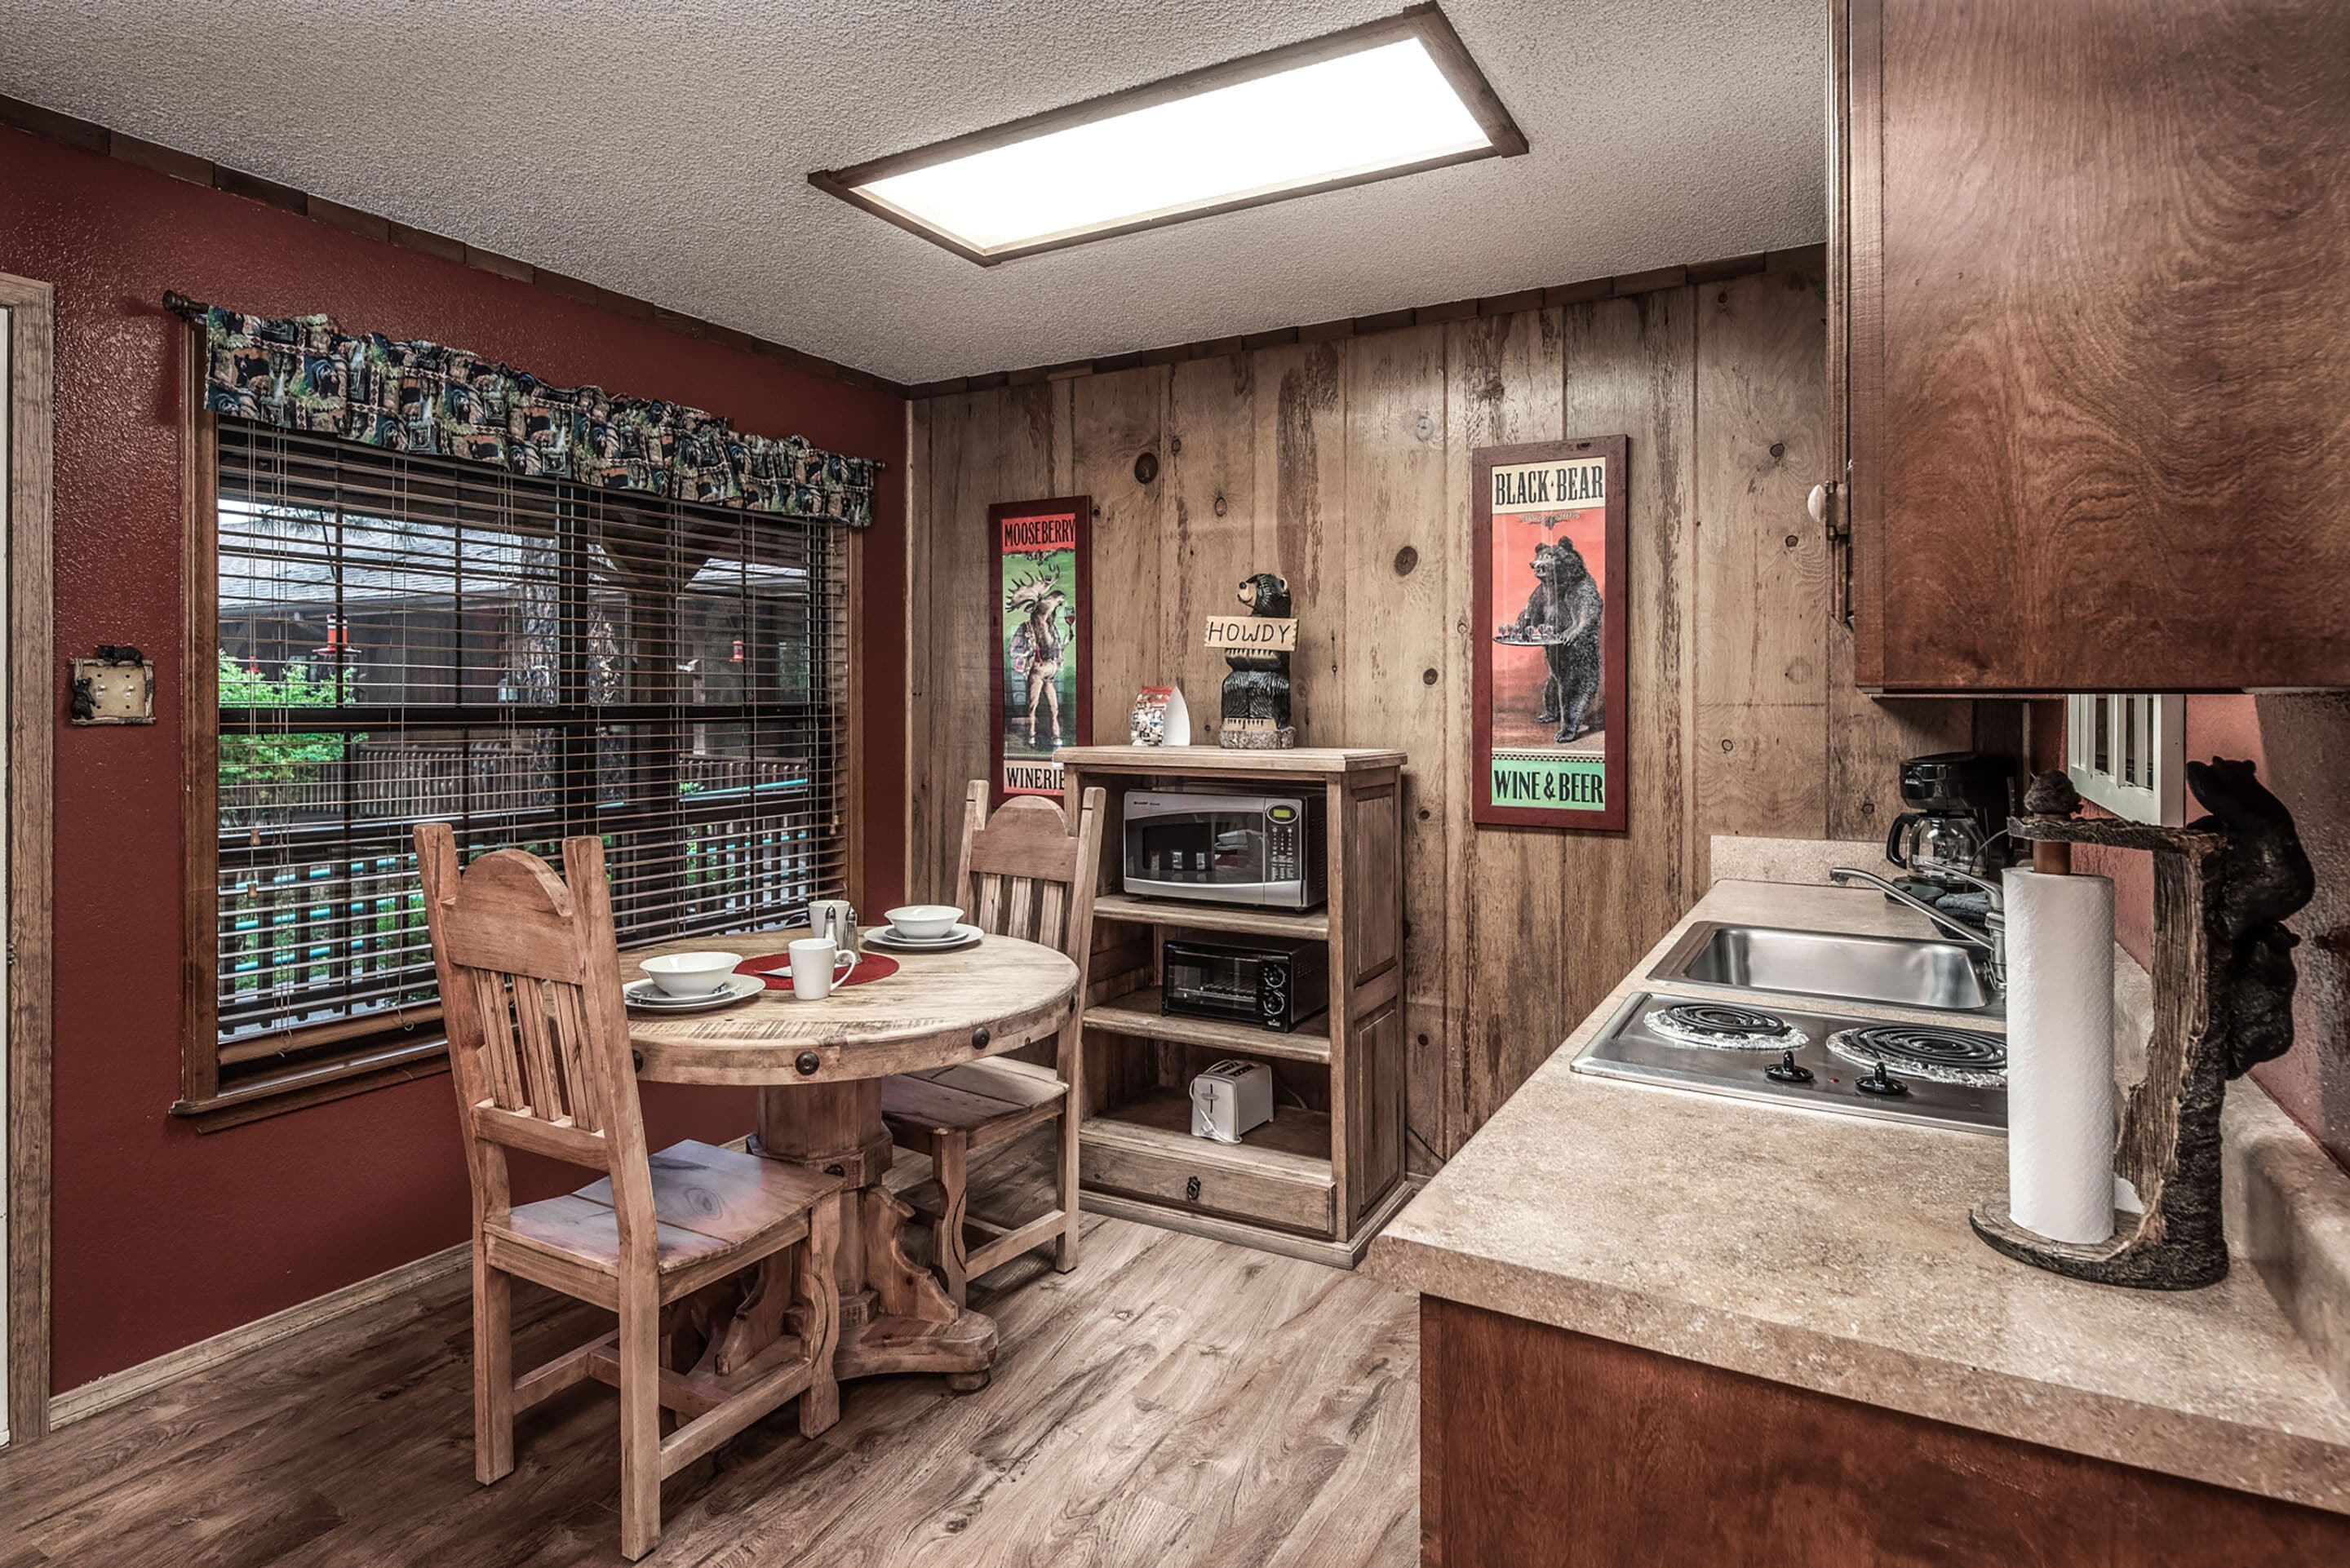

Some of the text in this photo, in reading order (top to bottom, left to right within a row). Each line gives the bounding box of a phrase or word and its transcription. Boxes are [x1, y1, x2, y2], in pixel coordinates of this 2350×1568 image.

[1495, 465, 1603, 506] BLACK BEAR
[1004, 519, 1075, 547] MOOSEBERRY
[1208, 621, 1291, 644] HOWDY
[1006, 767, 1064, 791] WINERIE
[1493, 770, 1604, 804] WINE & BEER
